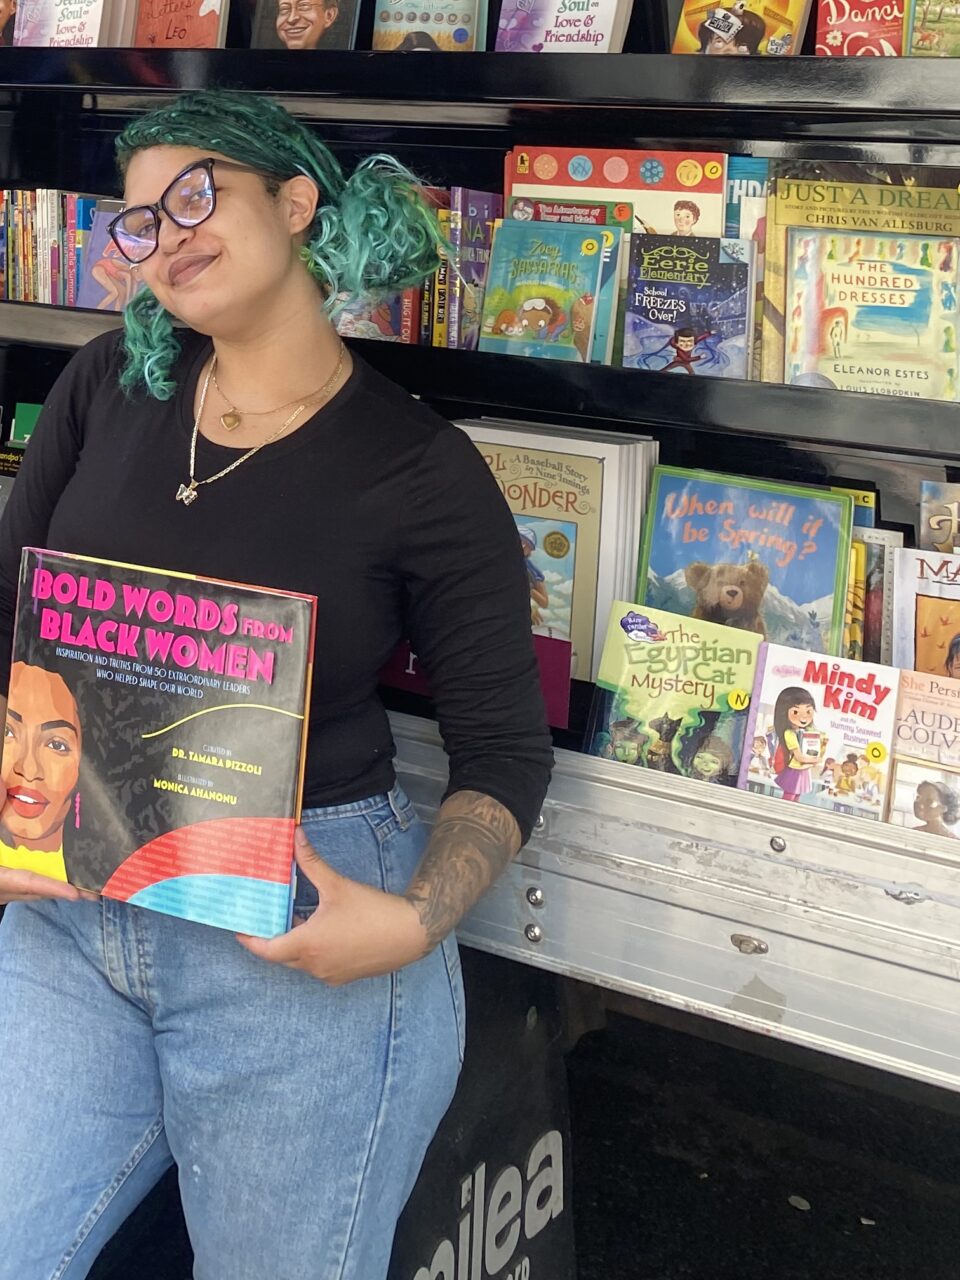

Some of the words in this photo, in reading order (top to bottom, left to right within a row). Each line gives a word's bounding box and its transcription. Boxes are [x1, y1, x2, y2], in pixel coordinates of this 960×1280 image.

[58, 7, 83, 23] Soul
[554, 16, 581, 28] Love
[584, 15, 595, 27] &
[56, 24, 77, 35] Love
[544, 30, 604, 46] Friendship
[780, 182, 843, 204] JUST
[851, 187, 869, 205] A
[806, 213, 847, 225] CHRIS
[851, 217, 878, 227] VAN
[881, 218, 953, 232] ALLSBURG
[68, 229, 76, 266] Umbrella
[529, 240, 562, 258] Zoey
[641, 255, 709, 272] Eerie
[857, 262, 887, 273] THE
[68, 269, 76, 303] Summer
[640, 267, 710, 289] Elementary
[831, 274, 914, 289] HUNDRED
[644, 286, 667, 296] School
[838, 291, 906, 305] DRESSES
[403, 298, 412, 316] HUG
[436, 289, 447, 324] FAILURE
[635, 293, 686, 312] FREEZES
[403, 317, 411, 325] IT
[649, 309, 677, 322] Over!
[833, 364, 890, 376] ELEANOR
[895, 369, 929, 380] ESTES
[513, 454, 522, 464] A
[523, 455, 563, 472] Baseball
[564, 464, 588, 482] Story
[525, 465, 534, 474] in
[536, 467, 557, 480] Nine
[558, 473, 590, 496] Innings
[500, 479, 586, 515] ONDER
[665, 491, 734, 520] When
[748, 502, 797, 526] will
[802, 515, 824, 538] it
[682, 522, 710, 544] be
[32, 568, 116, 611] BOLD
[122, 585, 238, 636] WORDS
[243, 618, 294, 643] FROM
[666, 624, 700, 644] The
[40, 608, 141, 658] BLACK
[145, 628, 275, 685] WOMEN
[624, 639, 752, 675] Egyptian
[55, 647, 93, 663] INSPIRATION
[94, 655, 108, 666] AND
[109, 658, 131, 671] TRUTHS
[132, 662, 153, 675] FROM
[154, 667, 166, 678] 50
[168, 671, 221, 689] EXTRAORDINARY
[222, 682, 251, 695] LEADERS
[693, 663, 737, 685] Cat
[96, 669, 114, 680] WHO
[115, 673, 138, 685] HELPED
[139, 678, 158, 690] SHAPE
[159, 682, 176, 693] OUR
[177, 684, 204, 699] WORLD
[631, 673, 715, 709] Mystery
[803, 660, 891, 705] Mindy
[901, 676, 925, 691] She
[735, 693, 748, 706] N
[823, 684, 877, 721] Kim
[830, 721, 855, 733] Yummy
[856, 725, 881, 738] Seaweed
[172, 747, 187, 760] DR.
[188, 751, 224, 768] TAMARA
[225, 759, 262, 776] PIZZOLI
[154, 778, 189, 795] MONICA
[190, 788, 237, 805] AHANONU
